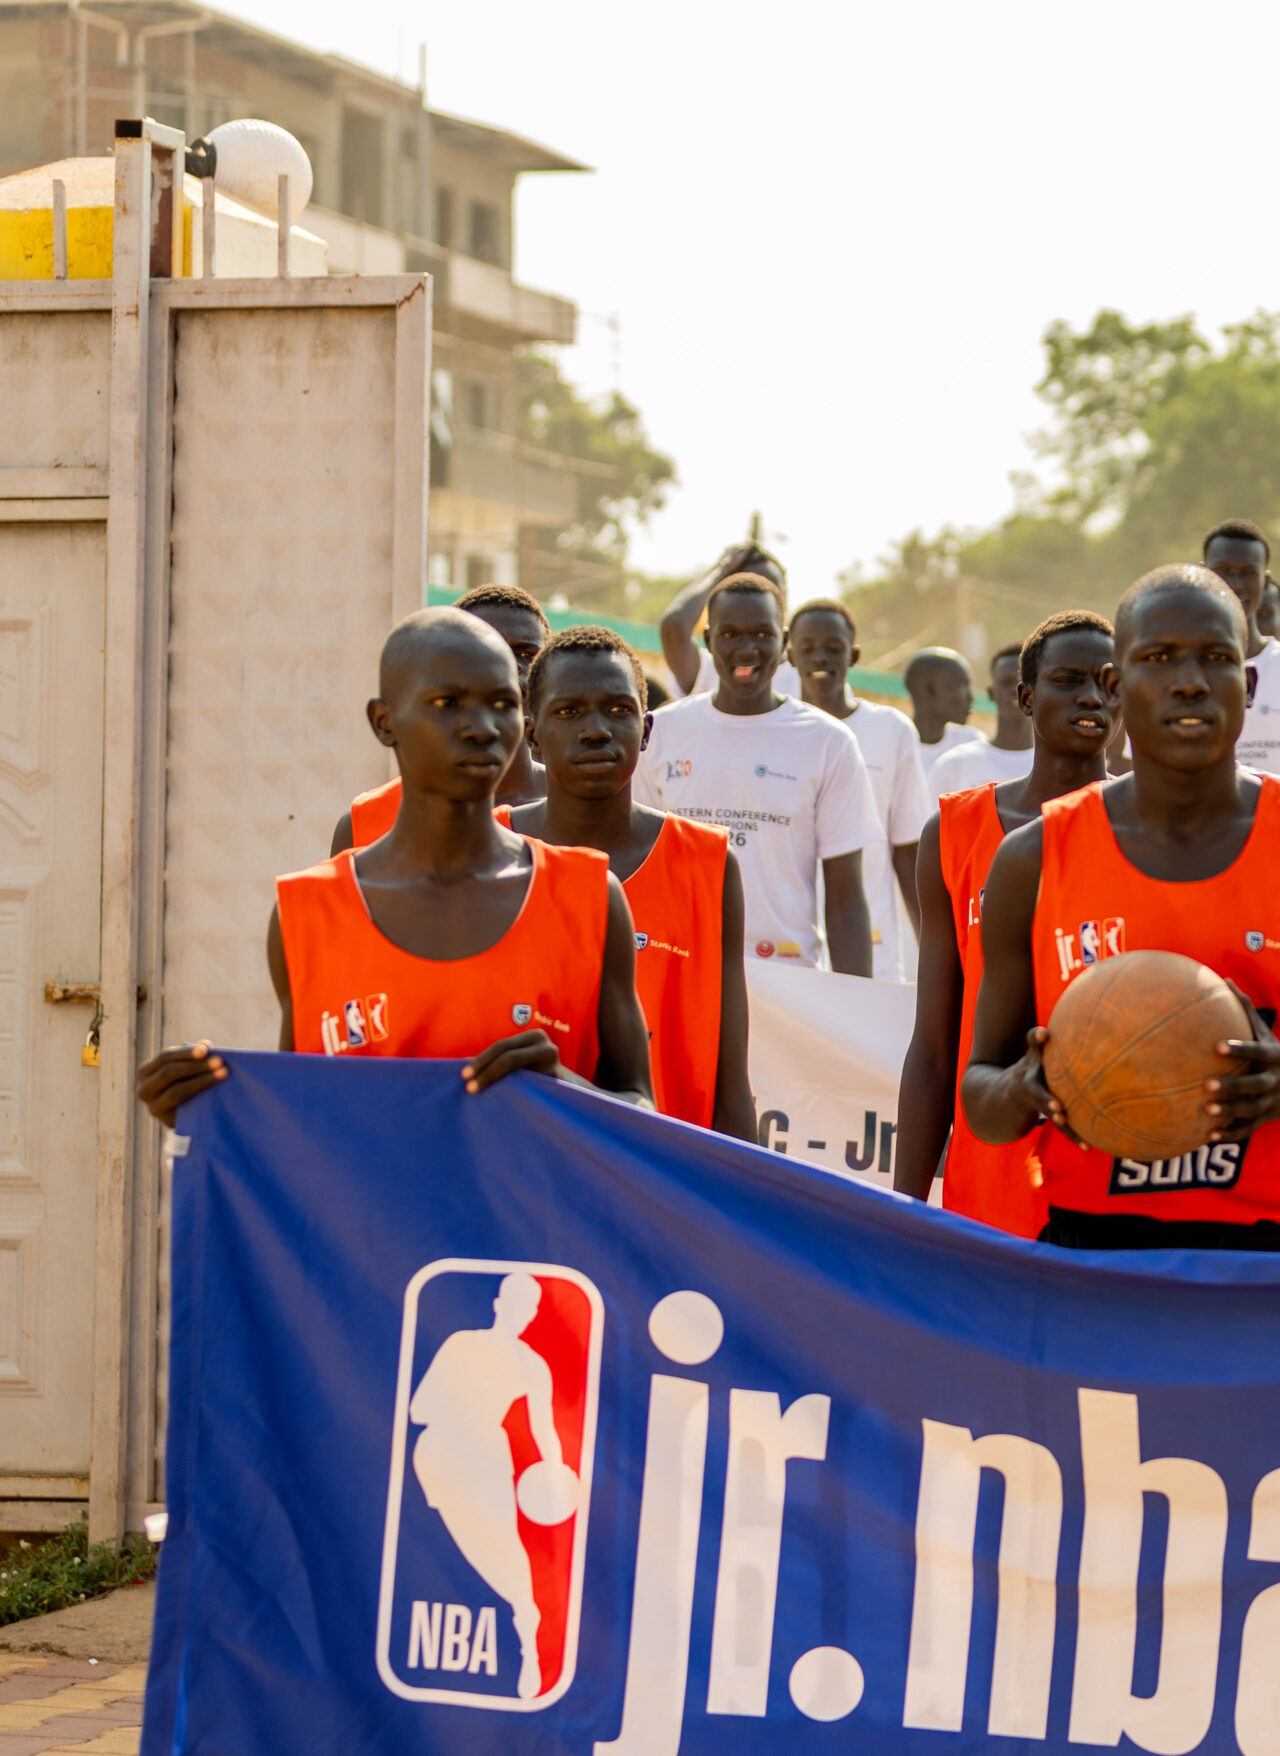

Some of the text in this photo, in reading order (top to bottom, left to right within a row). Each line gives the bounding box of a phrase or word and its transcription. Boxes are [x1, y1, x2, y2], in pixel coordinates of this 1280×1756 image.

[675, 808, 792, 827] STERN CONFERENCE
[728, 832, 747, 847] 26
[1054, 927, 1082, 981] jr.
[321, 1010, 348, 1057] jr.
[407, 1600, 498, 1677] NBA
